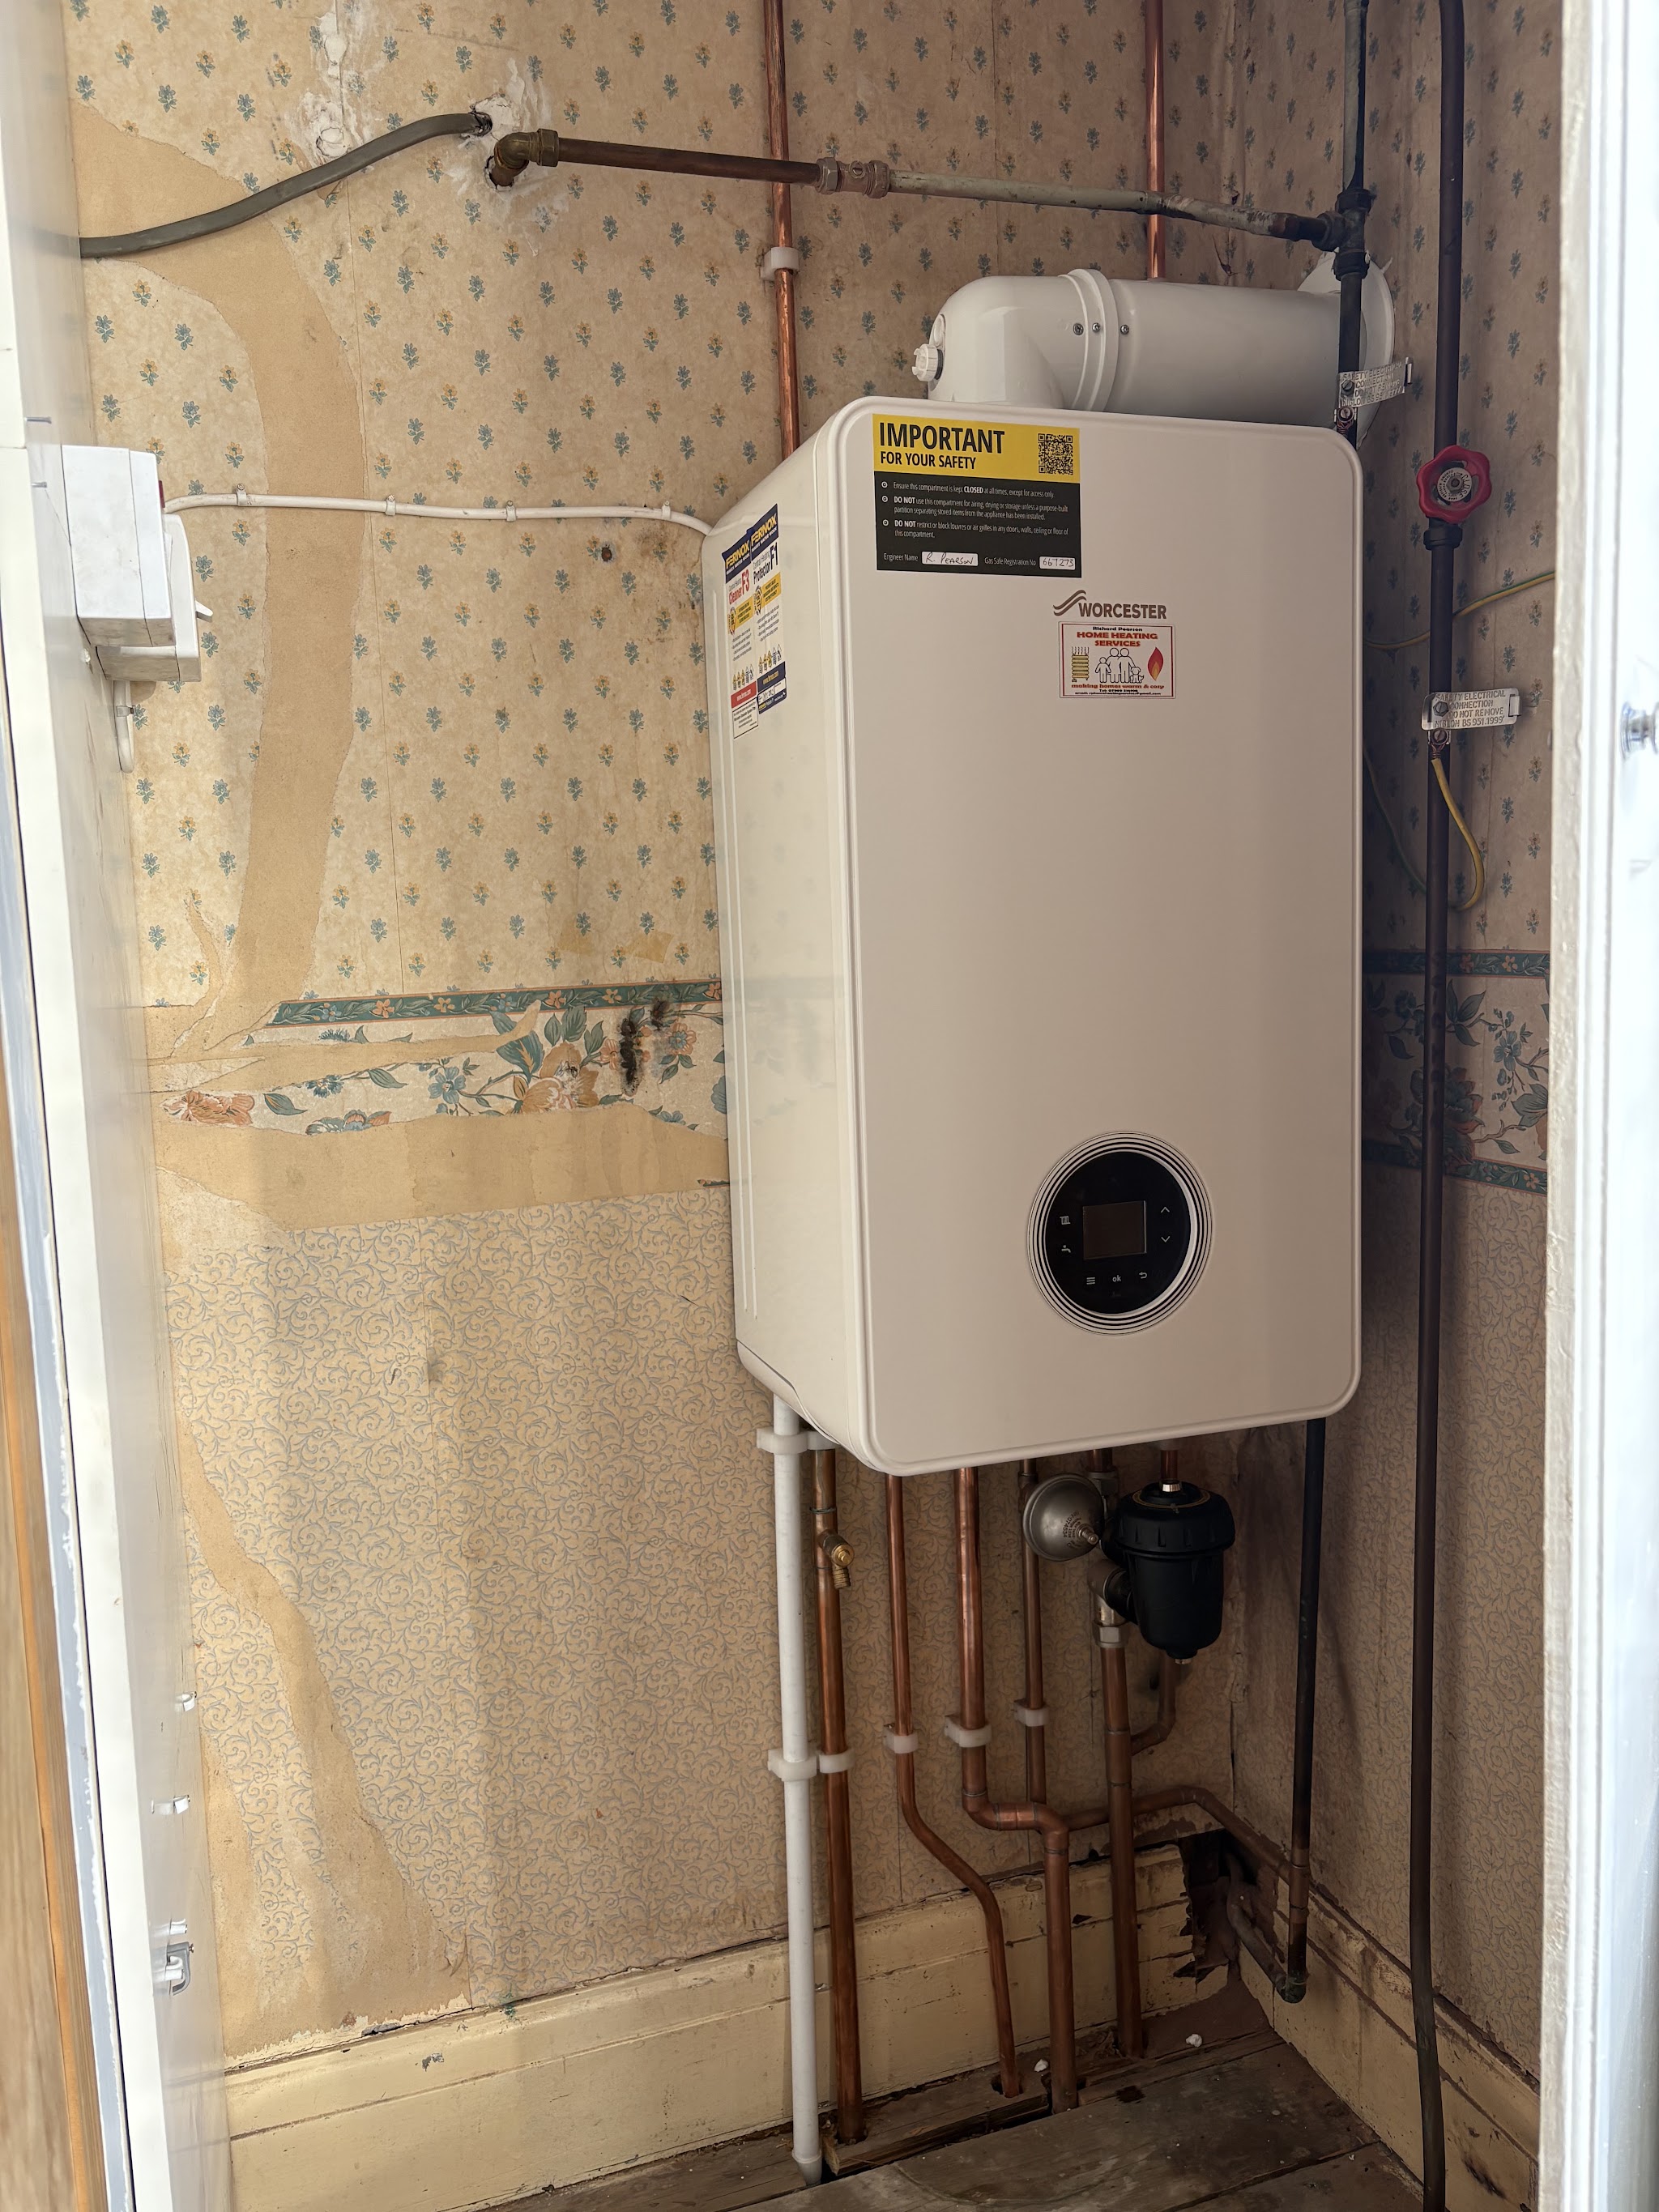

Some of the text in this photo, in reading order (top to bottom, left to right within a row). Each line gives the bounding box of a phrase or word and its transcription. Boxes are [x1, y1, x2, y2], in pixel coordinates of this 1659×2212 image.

[880, 422, 1005, 454] IMPORTANT
[881, 451, 976, 470] FOR YOUR SAFETY
[893, 482, 909, 490] Ensure
[910, 483, 918, 491] this
[919, 484, 949, 492] compartment
[953, 485, 963, 494] kept
[963, 486, 983, 494] CLOSED
[995, 488, 1009, 497] times,
[933, 498, 963, 507] compartment
[971, 501, 984, 509] airing,
[985, 501, 999, 510] drying
[1004, 503, 1021, 511] storage
[1039, 504, 1068, 513] purpose-built
[894, 506, 913, 514] partition
[914, 507, 937, 517] separating
[965, 509, 976, 517] from
[984, 510, 1005, 519] appliance
[1006, 511, 1014, 519] has
[1014, 511, 1026, 519] been
[1026, 513, 1046, 521] installed.
[750, 513, 778, 547] FERNOX
[894, 529, 935, 539] this compartment.
[904, 520, 916, 528] NOT
[917, 521, 932, 529] restrict
[938, 522, 950, 530] block
[950, 522, 966, 531] louvres
[979, 524, 992, 533] grilles
[1006, 525, 1021, 534] doors,
[1021, 526, 1033, 534] walls,
[1034, 526, 1047, 535] ceiling
[726, 540, 750, 570] FERNOX
[753, 560, 770, 584] Protector
[770, 541, 778, 570] F1
[884, 552, 903, 562] Engineer
[904, 553, 919, 561] Name
[984, 556, 993, 565] Gas
[994, 557, 1004, 565] Safe
[1004, 557, 1029, 566] Registration
[729, 586, 743, 605] Cleaner
[742, 569, 750, 595] F3
[1078, 603, 1167, 619] WORCESTER
[1435, 689, 1506, 701] SAFETY ELECTRICAL
[1449, 700, 1494, 710] CONNECTION
[1449, 707, 1504, 719] DO NOT REMOVE
[1462, 719, 1472, 727] BS
